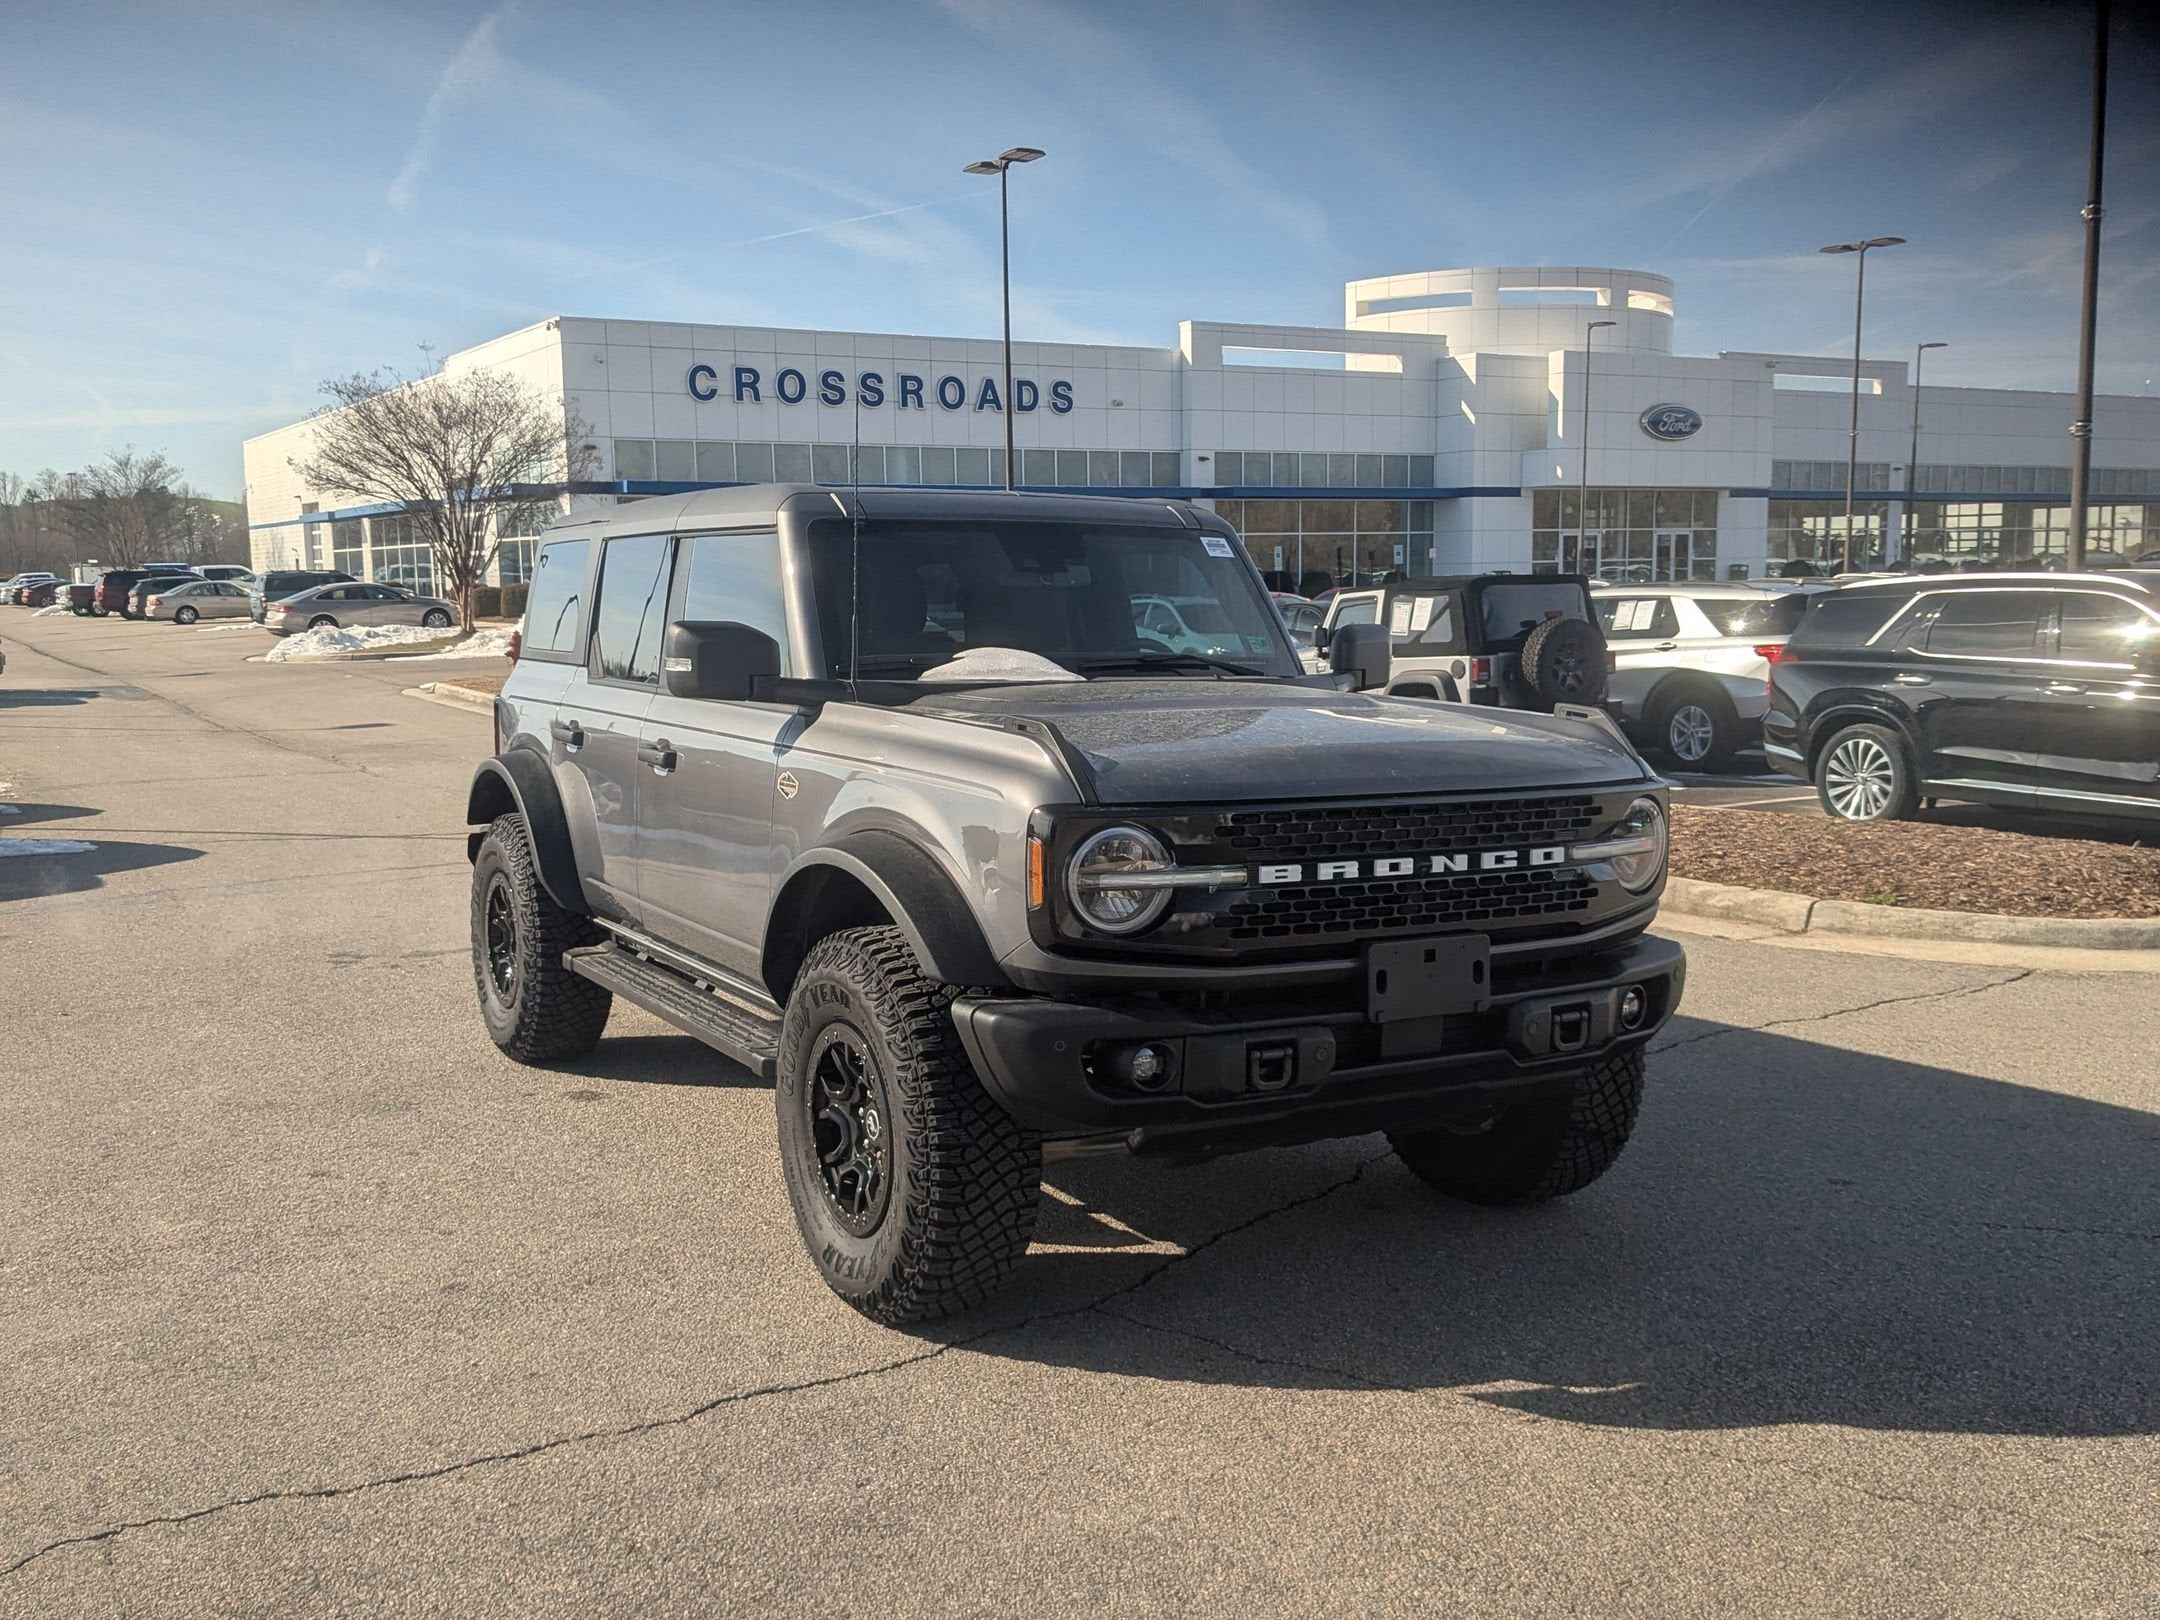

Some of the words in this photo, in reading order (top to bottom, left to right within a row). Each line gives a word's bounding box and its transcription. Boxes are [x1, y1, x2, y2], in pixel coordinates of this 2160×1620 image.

[687, 364, 1075, 415] CROSSROADS
[1659, 412, 1693, 432] Ford
[1258, 846, 1566, 884] BRONCO
